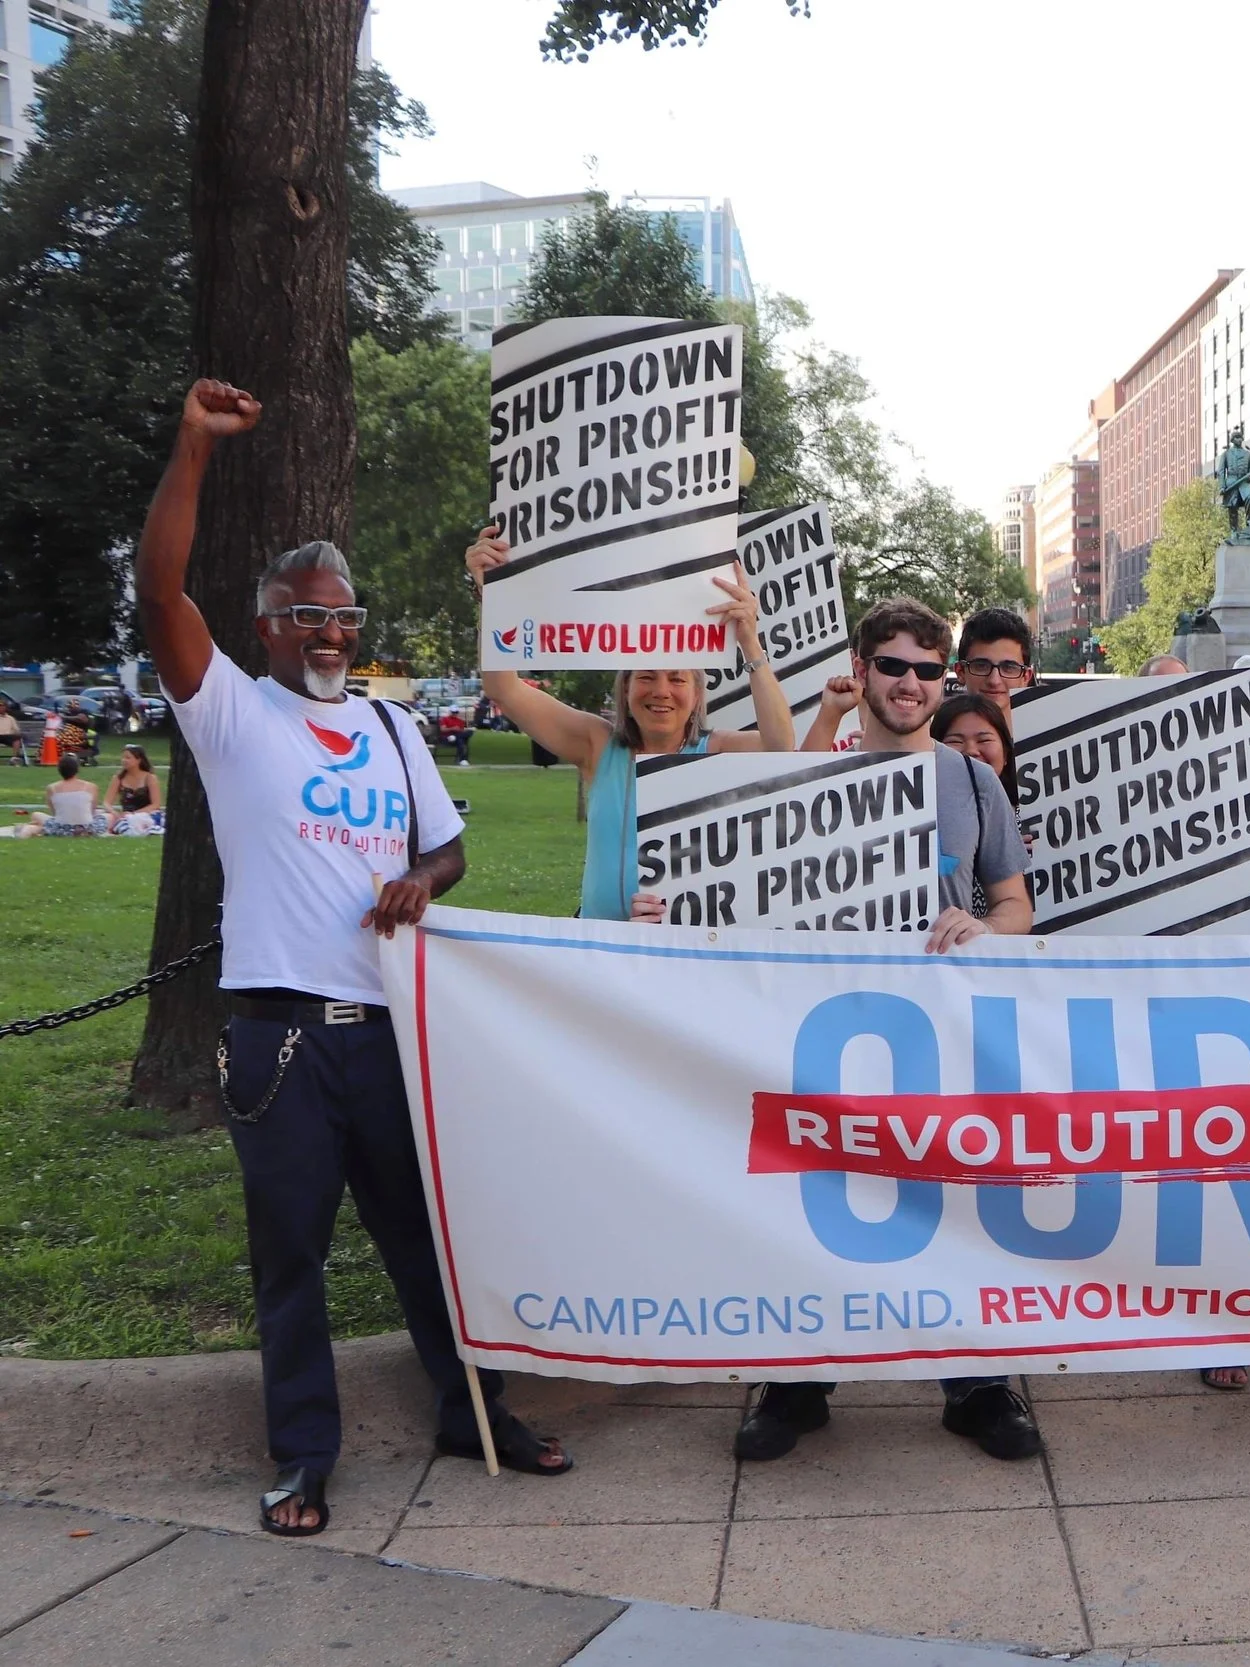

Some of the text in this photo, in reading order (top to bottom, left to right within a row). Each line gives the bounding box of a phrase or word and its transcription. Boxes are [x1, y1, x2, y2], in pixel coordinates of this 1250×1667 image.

[490, 336, 733, 446] SHUTDOWN
[489, 388, 742, 502] FOR PROFIT
[522, 618, 534, 660] OUR
[539, 623, 727, 654] REVOLUTION
[301, 775, 408, 833] OUR
[638, 764, 925, 888] SHUTDOWN
[1021, 795, 1103, 858] FOR
[757, 821, 937, 917] PROFIT
[513, 1291, 825, 1336] CAMPAIGNS
[844, 1288, 964, 1332] END.
